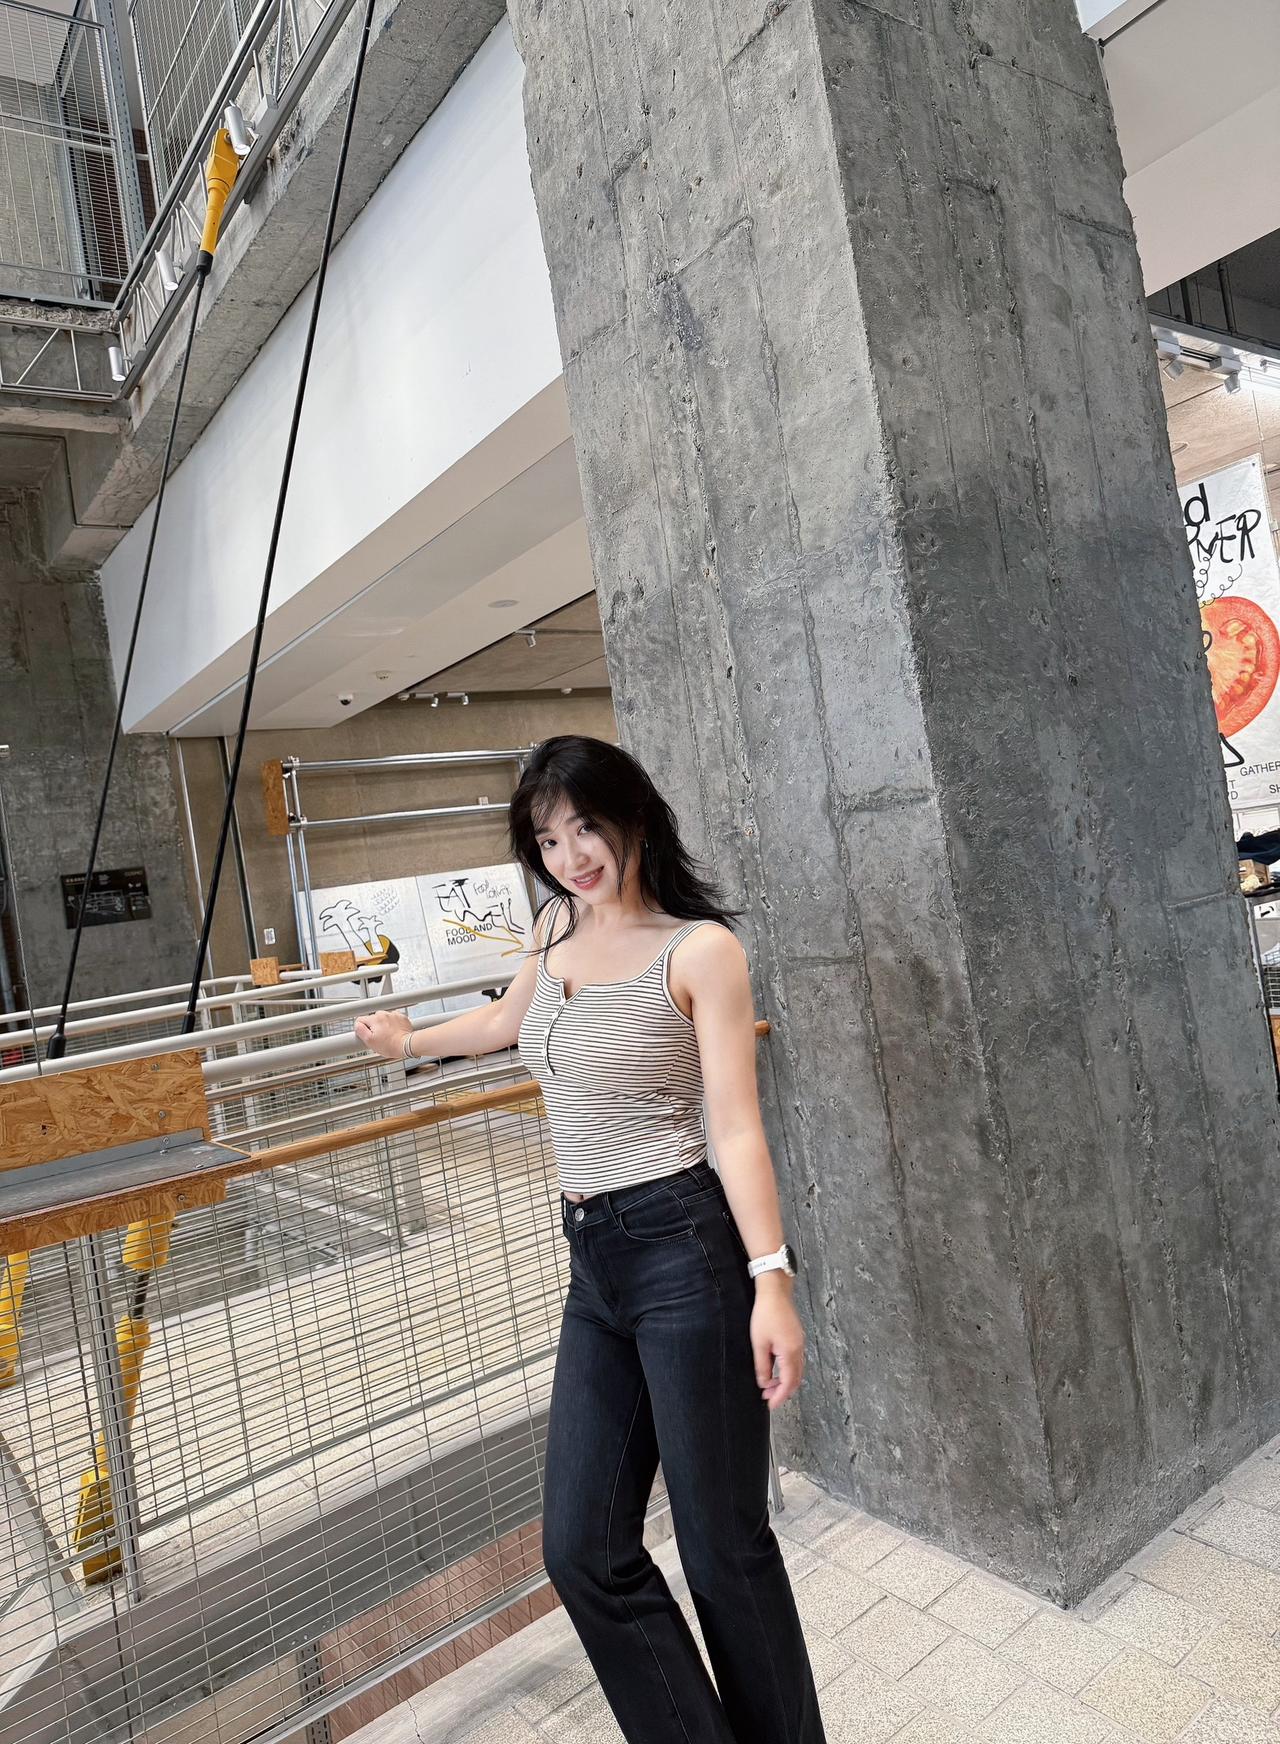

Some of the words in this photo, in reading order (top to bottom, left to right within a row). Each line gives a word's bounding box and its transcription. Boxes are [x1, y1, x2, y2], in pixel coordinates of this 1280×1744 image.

[432, 878, 471, 913] EAT
[454, 898, 525, 935] WELL
[446, 925, 471, 938] FOOD
[473, 922, 493, 933] AND
[447, 933, 477, 946] MOOD
